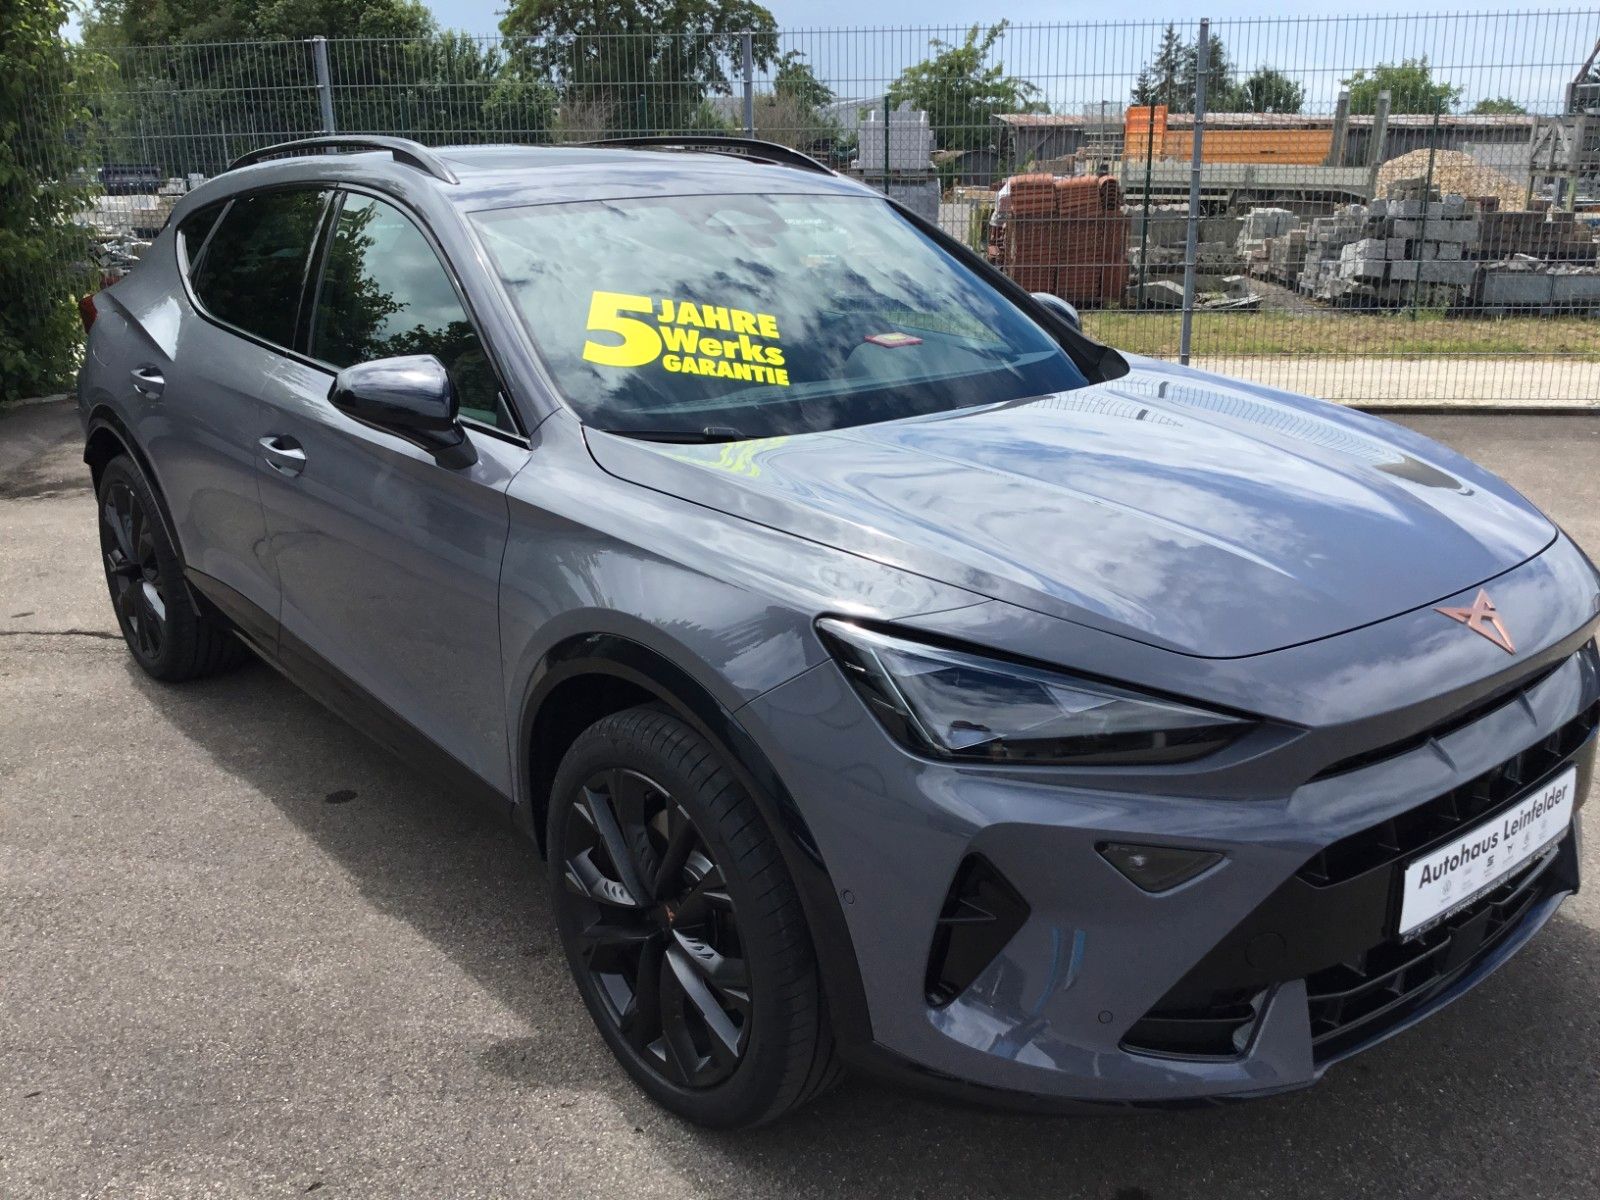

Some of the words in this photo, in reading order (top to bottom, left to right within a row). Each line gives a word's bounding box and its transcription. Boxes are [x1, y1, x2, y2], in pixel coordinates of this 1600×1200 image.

[582, 290, 661, 366] 5
[658, 300, 780, 338] JAHRE
[660, 328, 785, 366] Werks
[663, 354, 790, 386] GARANTIE
[1418, 830, 1499, 890] Autohaus
[1503, 785, 1568, 841] Leinfelder
